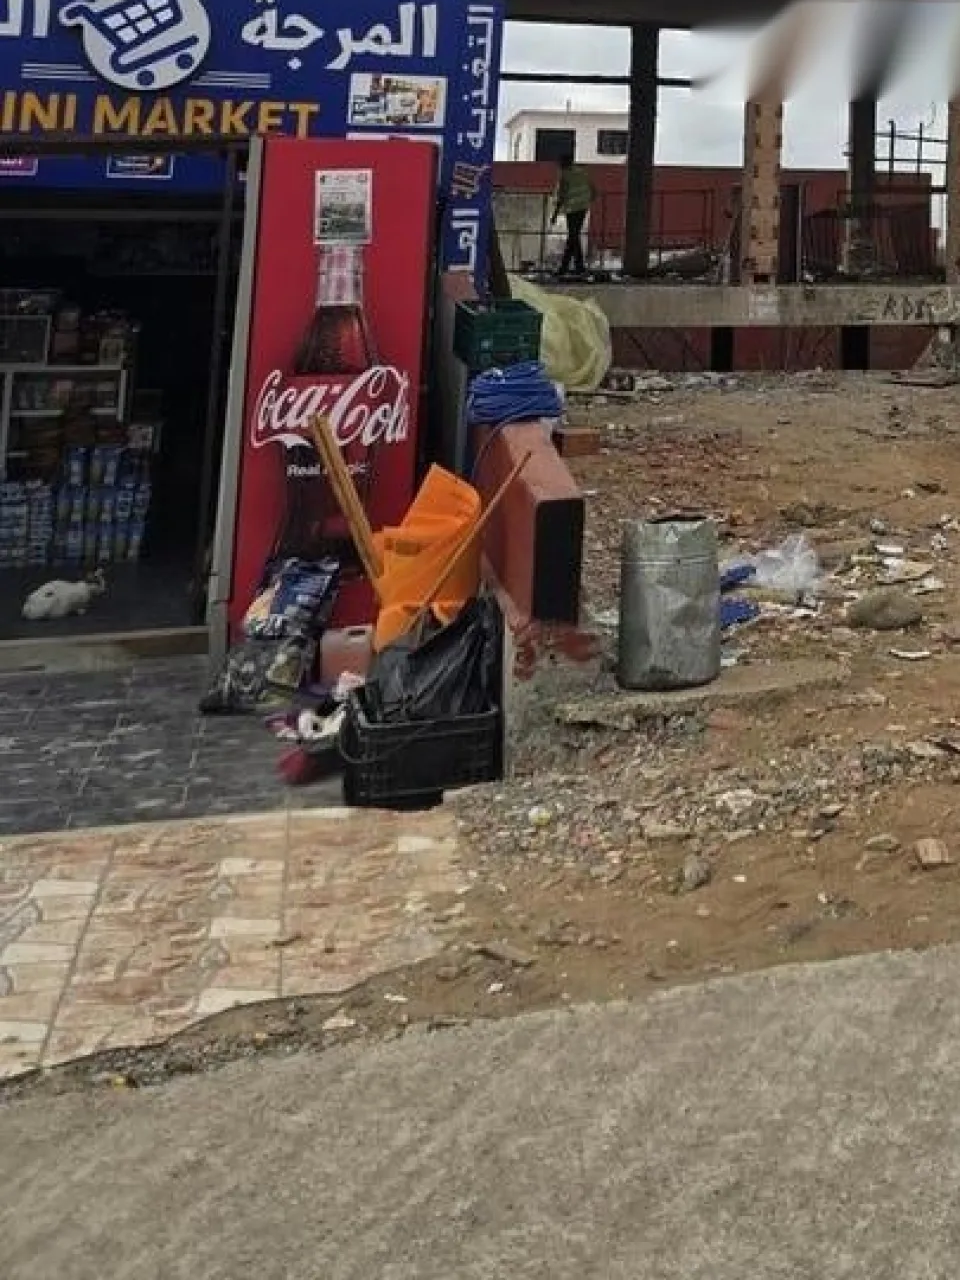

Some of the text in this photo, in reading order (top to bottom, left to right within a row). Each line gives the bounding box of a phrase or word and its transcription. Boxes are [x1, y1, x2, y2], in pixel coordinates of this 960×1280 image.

[0, 89, 77, 133] INI
[93, 93, 321, 138] MARKET
[457, 4, 495, 148] التغذية
[250, 365, 409, 449] Coca-Cola
